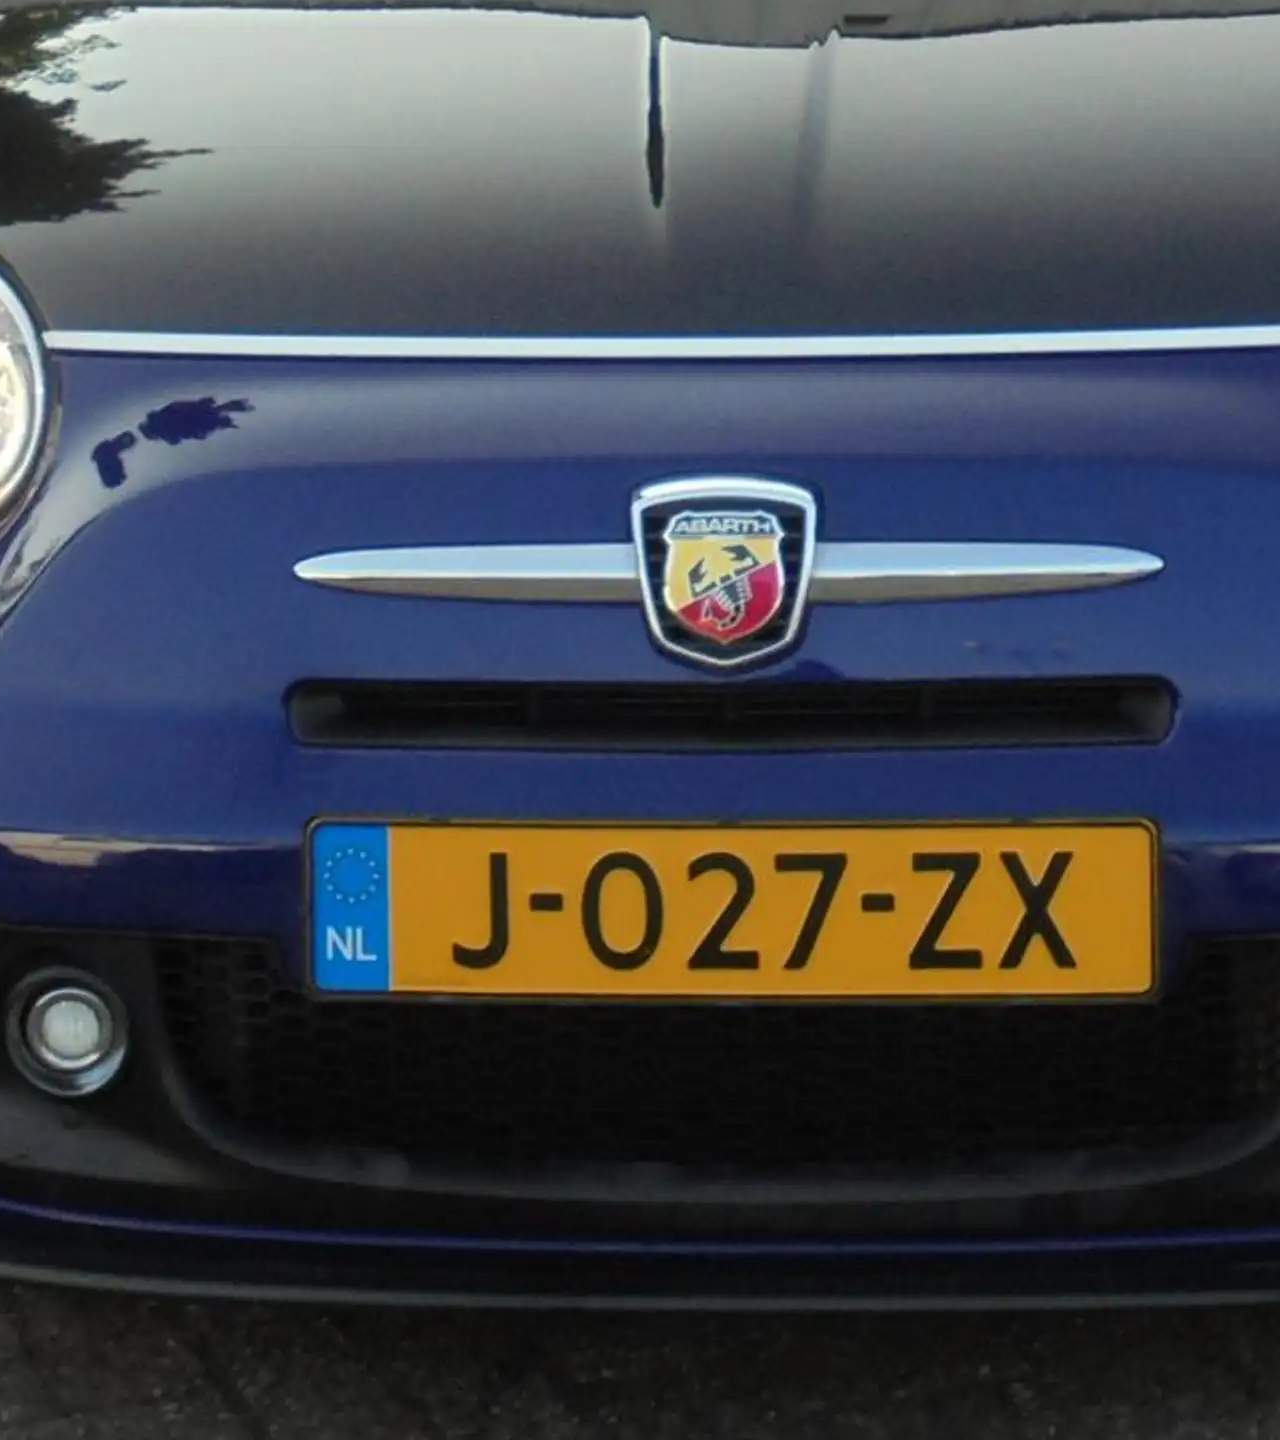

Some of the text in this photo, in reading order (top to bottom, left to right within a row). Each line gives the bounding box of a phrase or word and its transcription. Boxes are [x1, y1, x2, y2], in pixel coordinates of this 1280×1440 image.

[673, 517, 772, 534] ABARTH
[452, 850, 1077, 971] J-027-ZX
[325, 926, 377, 962] NL
